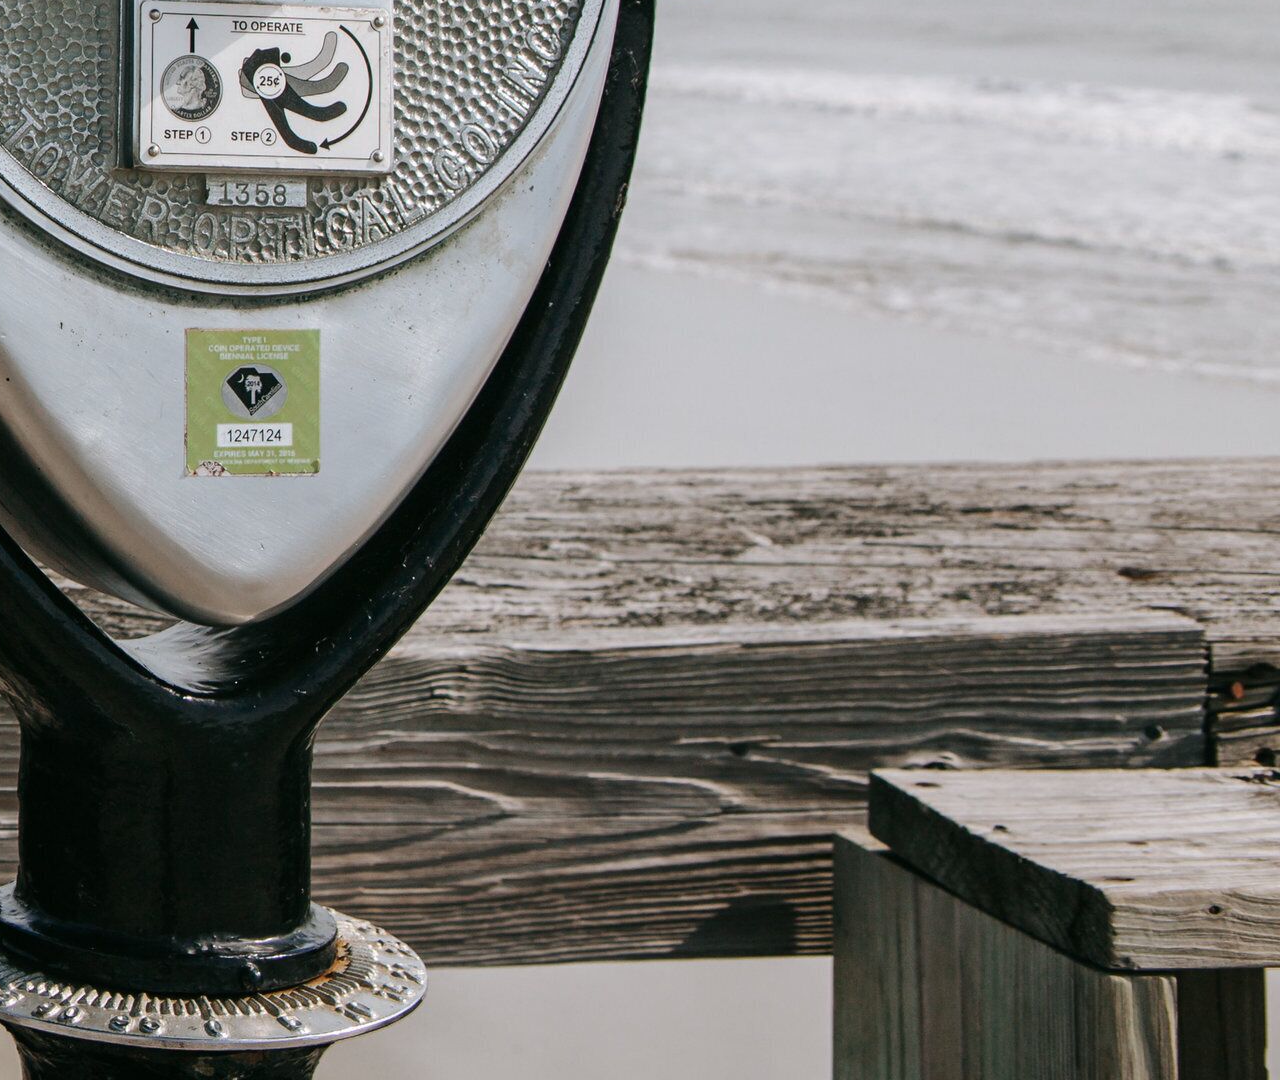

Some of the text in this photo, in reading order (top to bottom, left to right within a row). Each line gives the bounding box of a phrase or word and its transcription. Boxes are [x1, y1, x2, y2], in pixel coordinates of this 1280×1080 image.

[232, 20, 303, 33] TO OPERATE
[259, 76, 280, 88] 25¢
[164, 129, 193, 140] STEP
[231, 131, 259, 142] STEP
[4, 107, 169, 243] TOWER
[193, 184, 425, 261] OPTICAL
[218, 183, 287, 206] 1358
[229, 344, 271, 352] OPERATED
[272, 344, 300, 352] DEVICE
[227, 428, 282, 443] 1247124
[247, 450, 264, 458] MAY
